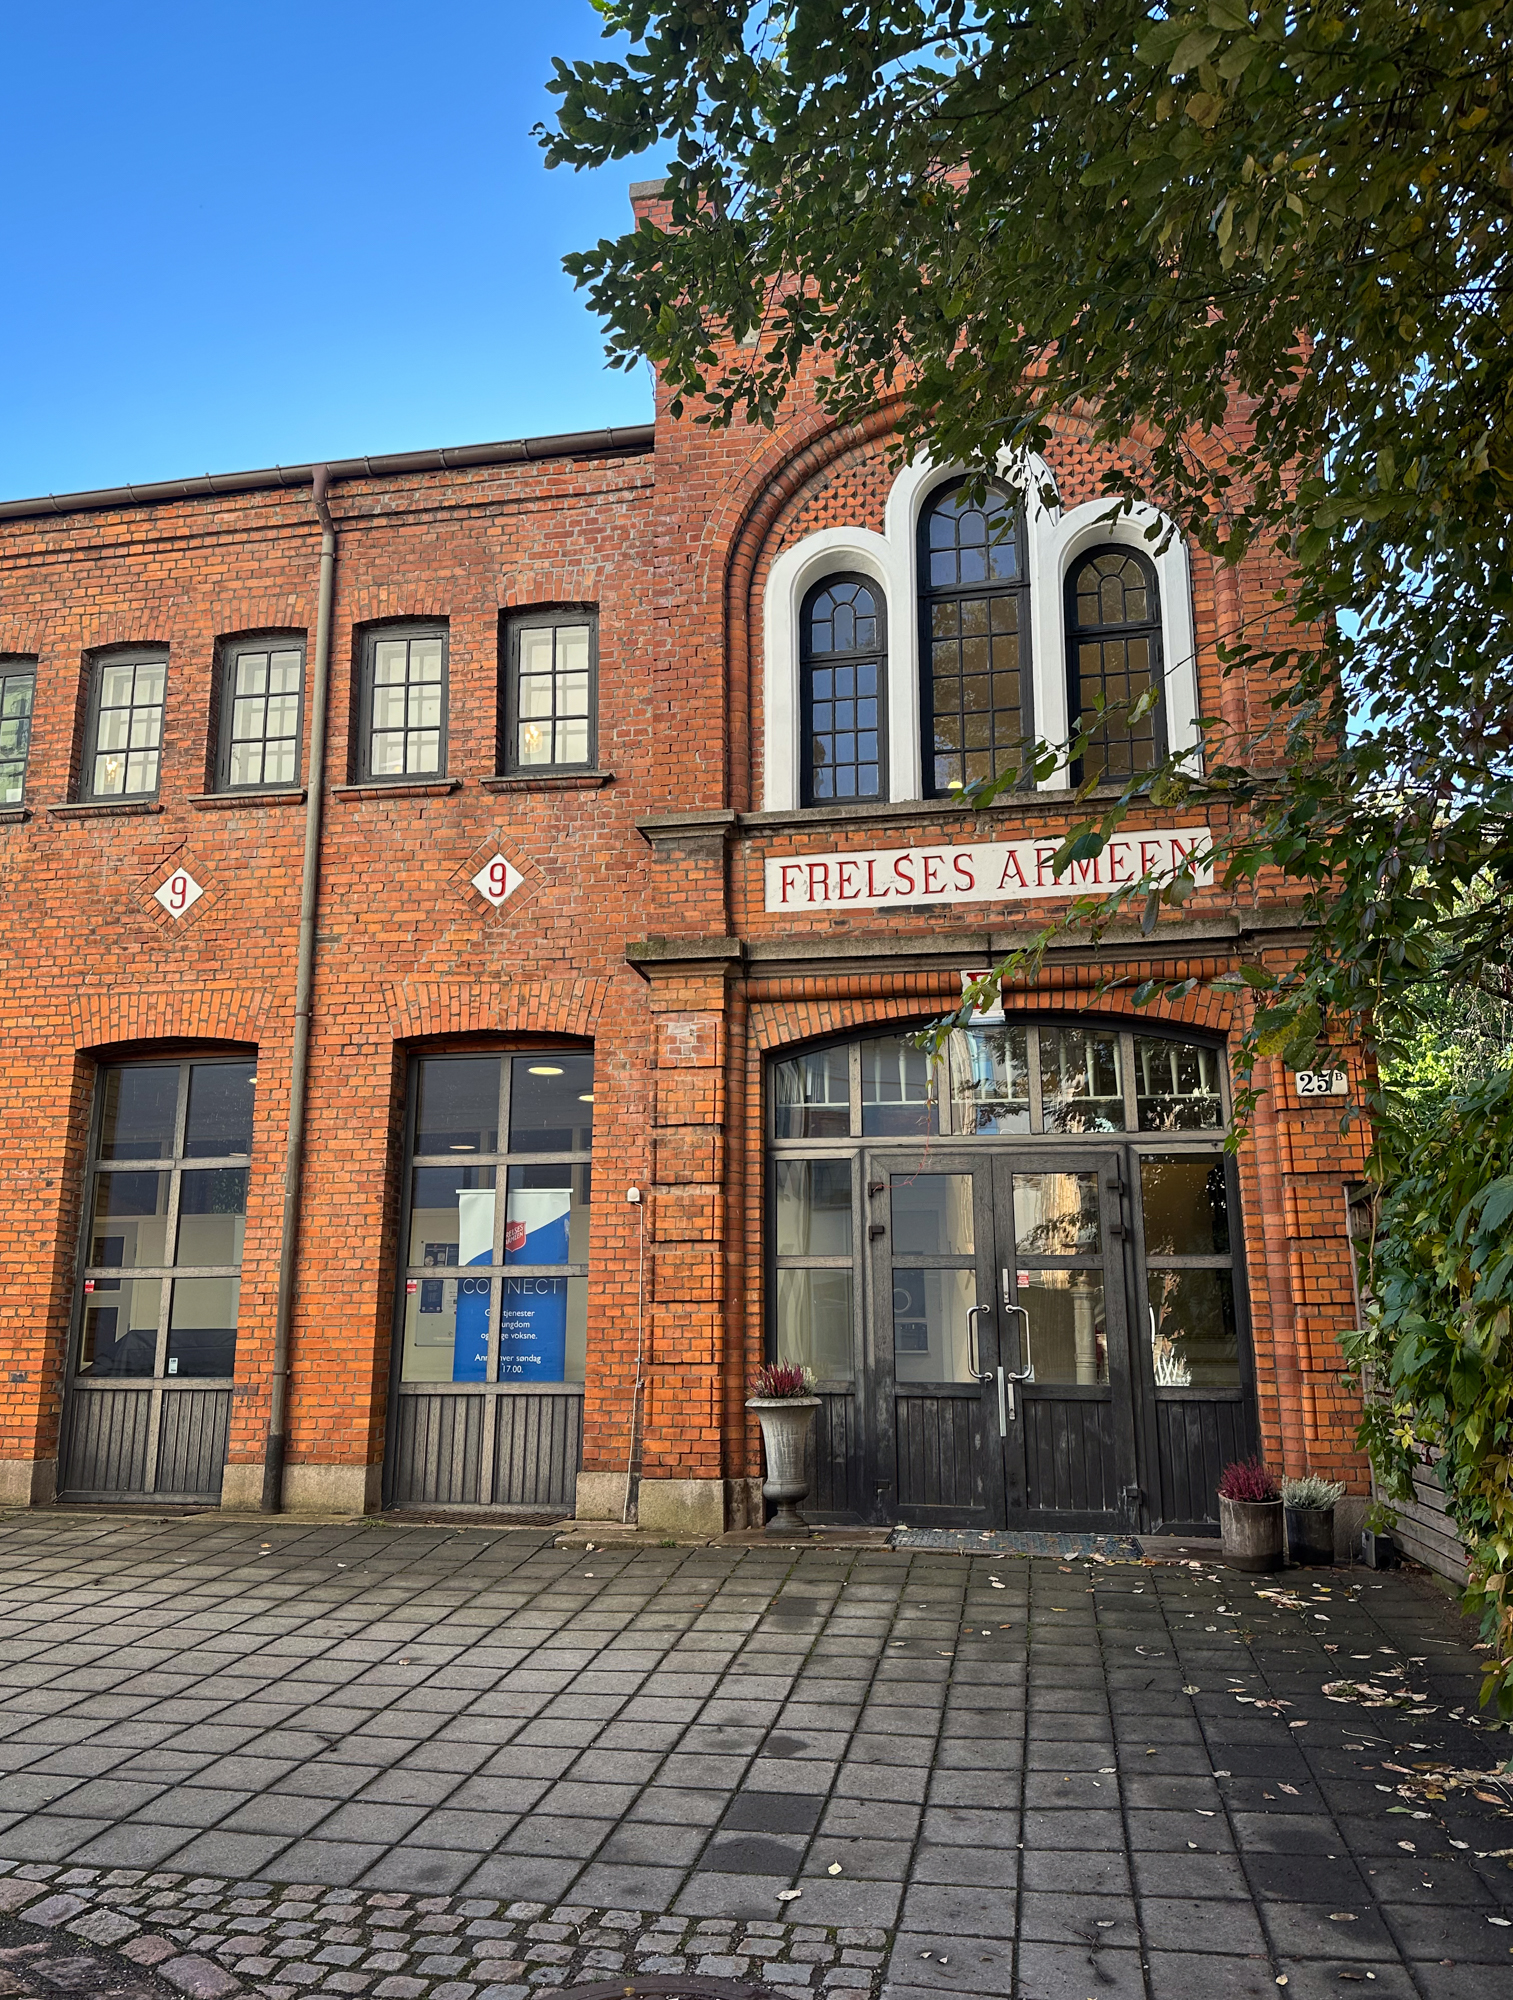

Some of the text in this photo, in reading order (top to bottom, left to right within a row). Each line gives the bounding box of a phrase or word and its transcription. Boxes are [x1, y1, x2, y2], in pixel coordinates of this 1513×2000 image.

[779, 837, 1199, 903] FRELSES ARMEEN
[489, 862, 506, 898] 9
[169, 876, 187, 910] 9
[463, 1278, 561, 1294] CONECT
[501, 1320, 531, 1330] ungdom
[511, 1331, 538, 1340] voksne.
[516, 1354, 542, 1364] søndag
